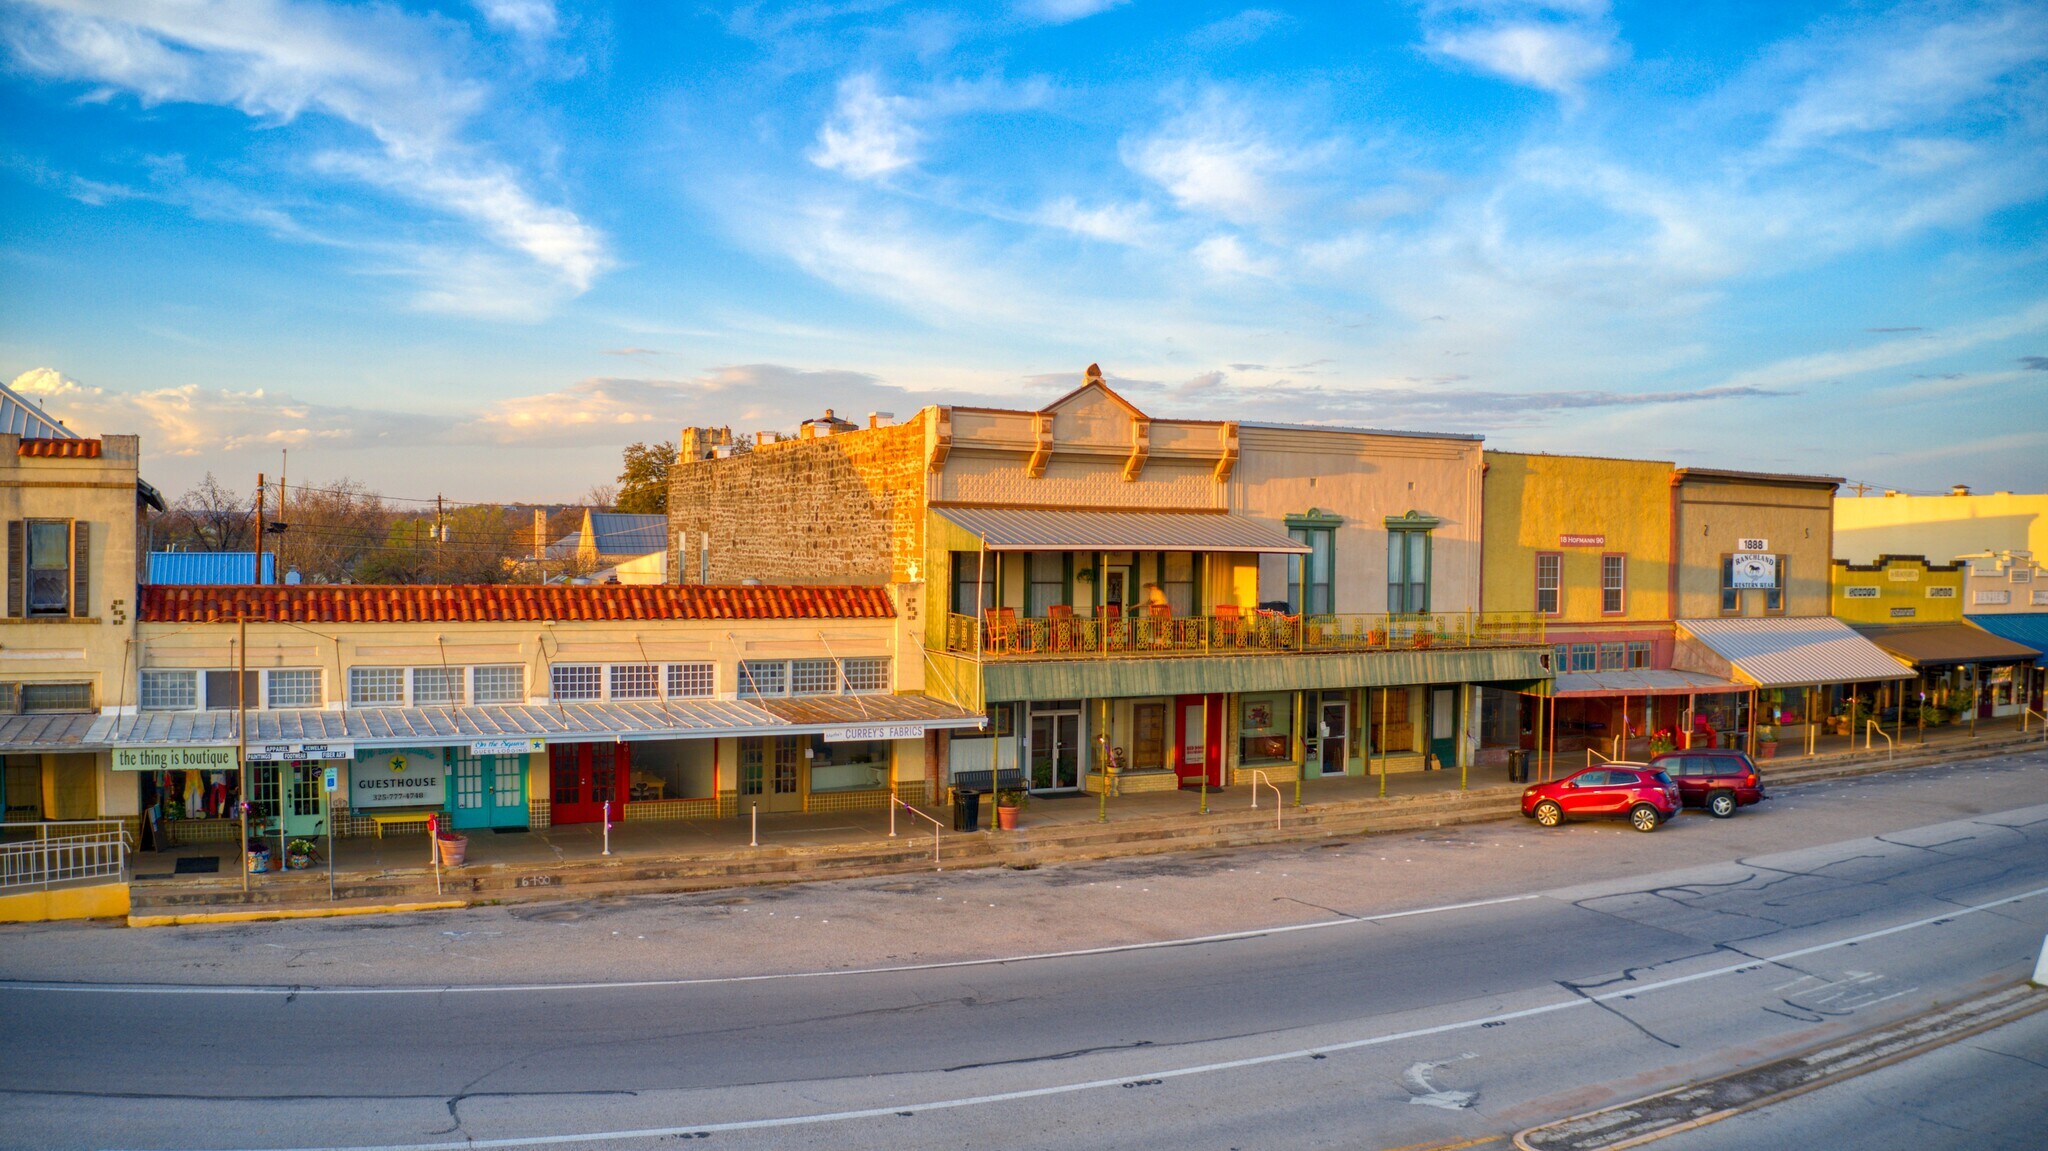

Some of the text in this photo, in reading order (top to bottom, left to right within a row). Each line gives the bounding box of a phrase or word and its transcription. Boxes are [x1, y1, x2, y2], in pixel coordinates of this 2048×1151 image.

[1744, 540, 1763, 549] 1888
[1735, 554, 1774, 566] RANCHLAND
[846, 727, 885, 739] CURREY'S
[889, 726, 922, 737] FABRICS
[119, 748, 229, 769] the thing is boutique
[359, 777, 436, 789] GUESTHOUSE
[373, 792, 424, 801] 325-777-4748
